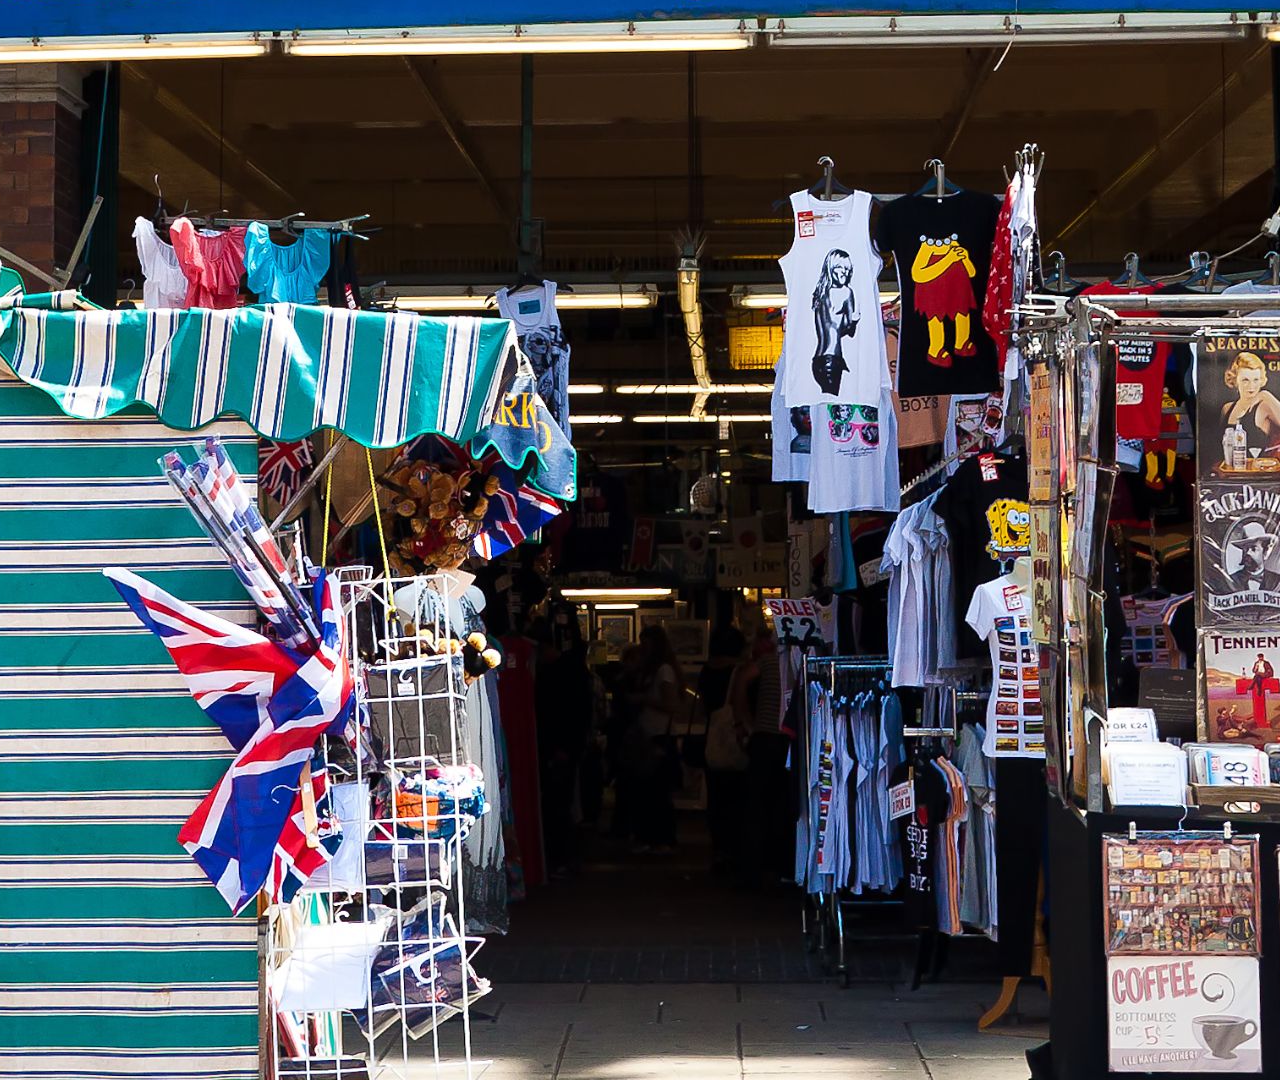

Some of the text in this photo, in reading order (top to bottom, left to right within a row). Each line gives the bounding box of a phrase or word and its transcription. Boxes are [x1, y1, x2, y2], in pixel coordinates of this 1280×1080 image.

[899, 396, 939, 413] BOYS
[1205, 491, 1243, 523] JACK
[1232, 595, 1260, 606] DANIEL
[769, 600, 815, 616] SALE
[1111, 960, 1198, 1005] COFFEE
[1115, 1012, 1176, 1023] BOTTOMLESS
[1115, 1026, 1133, 1036] CUP
[1137, 1053, 1158, 1065] HAVE
